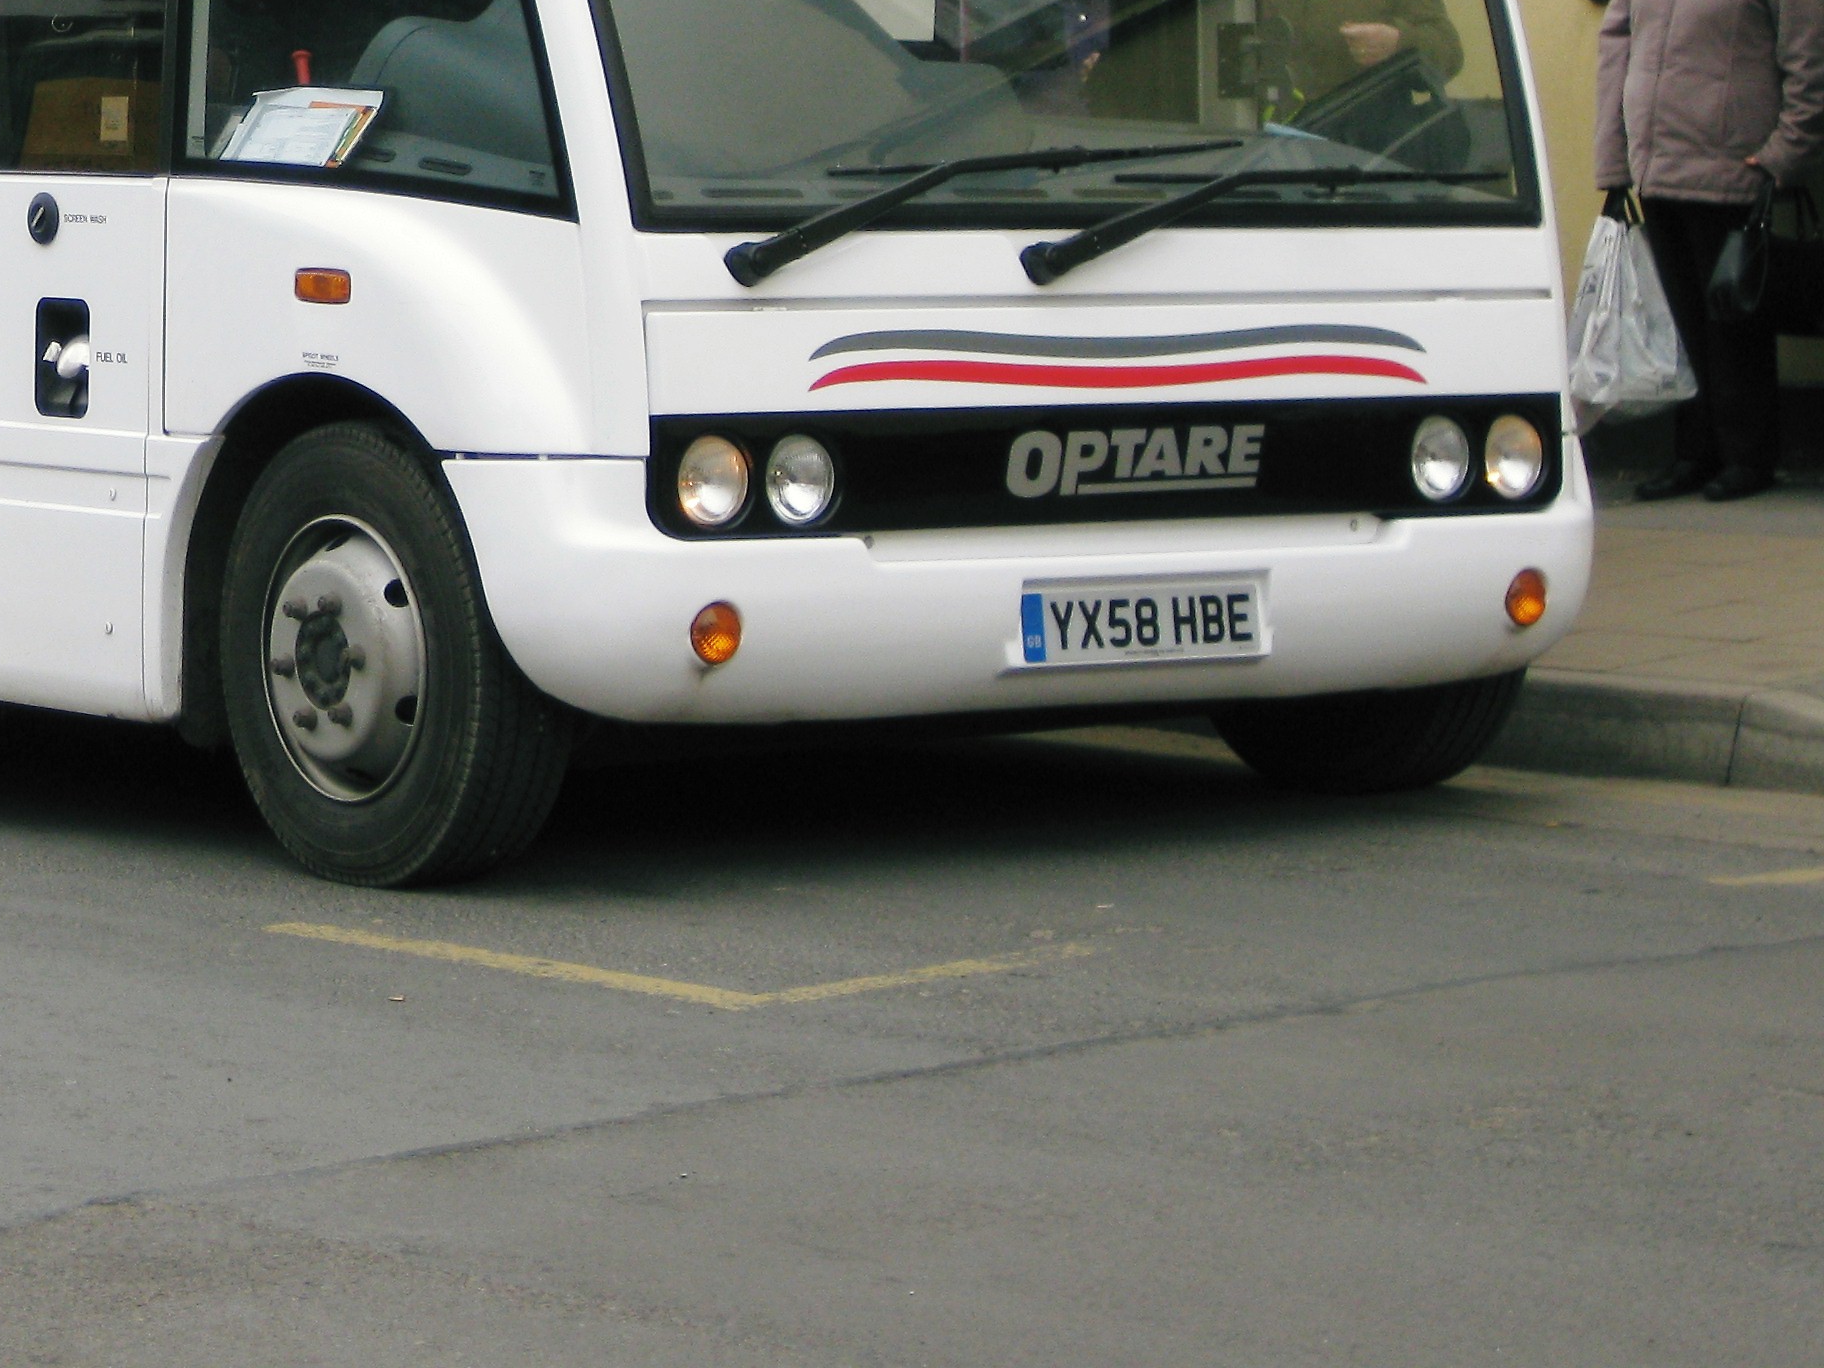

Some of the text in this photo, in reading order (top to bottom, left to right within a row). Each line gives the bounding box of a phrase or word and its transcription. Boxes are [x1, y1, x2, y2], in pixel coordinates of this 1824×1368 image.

[96, 351, 128, 364] FUEL OIL
[1006, 424, 1265, 498] OPTARE
[1049, 593, 1253, 651] YX58 HBE
